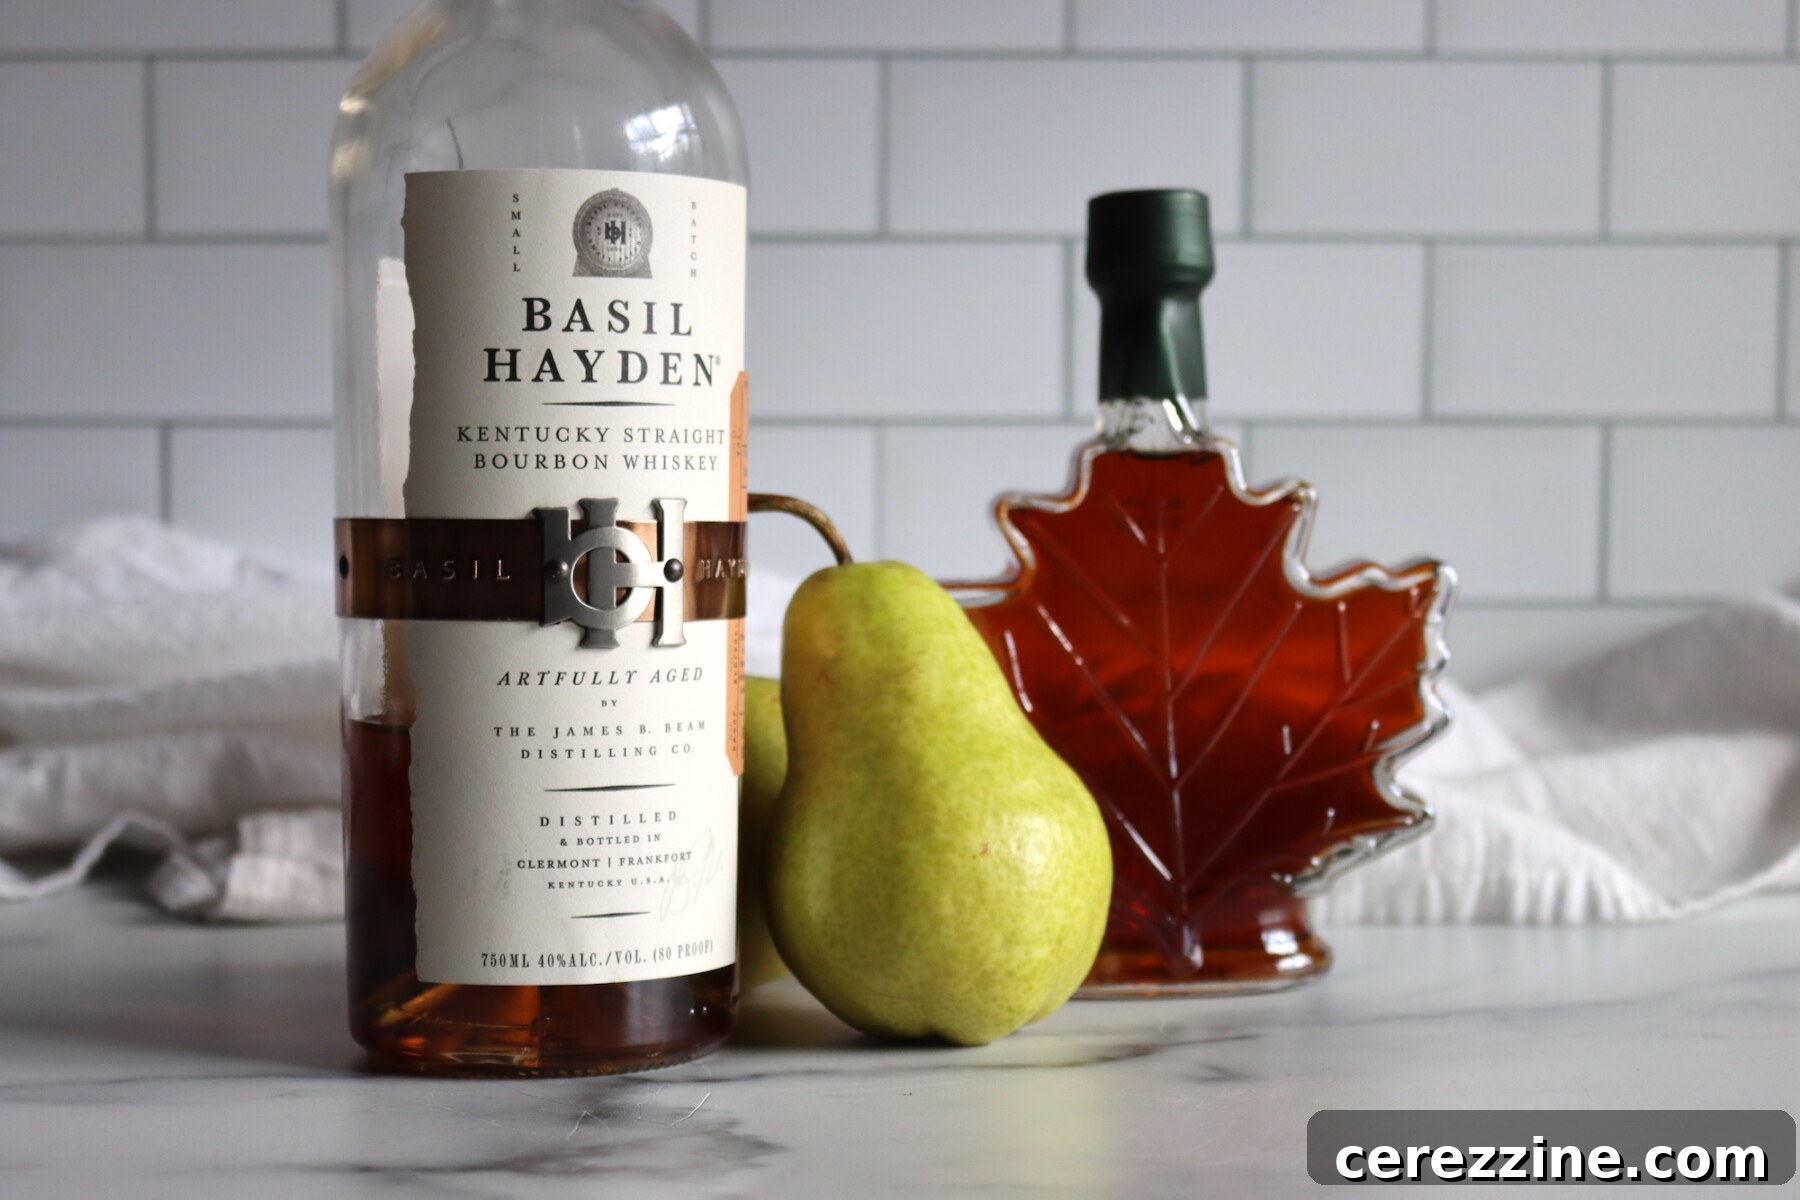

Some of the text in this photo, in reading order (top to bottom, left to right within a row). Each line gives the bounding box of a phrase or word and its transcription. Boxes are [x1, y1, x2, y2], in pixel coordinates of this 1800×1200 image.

[510, 193, 522, 274] SMALL
[690, 200, 698, 279] BATCH
[521, 297, 692, 336] BASIL
[483, 347, 714, 387] HAYDEN
[456, 426, 726, 445] KENTUCKY STRAIGHT
[473, 453, 718, 471] BOURBON WHISKEY
[389, 559, 511, 580] BASIL
[496, 667, 703, 686] ARTFULLY AGED
[494, 721, 706, 739] THE JAMES B. BEAM
[520, 743, 695, 759] DISTILLING CO.
[539, 810, 677, 827] DISTILLED
[560, 833, 661, 846] & BOTTLED IN
[517, 858, 601, 869] CLERMONT
[619, 851, 692, 867] FRANKFORT
[548, 879, 623, 889] KENTUCKY
[481, 953, 529, 968] 750ML
[652, 946, 672, 963] (80
[677, 939, 713, 960] PROOF)
